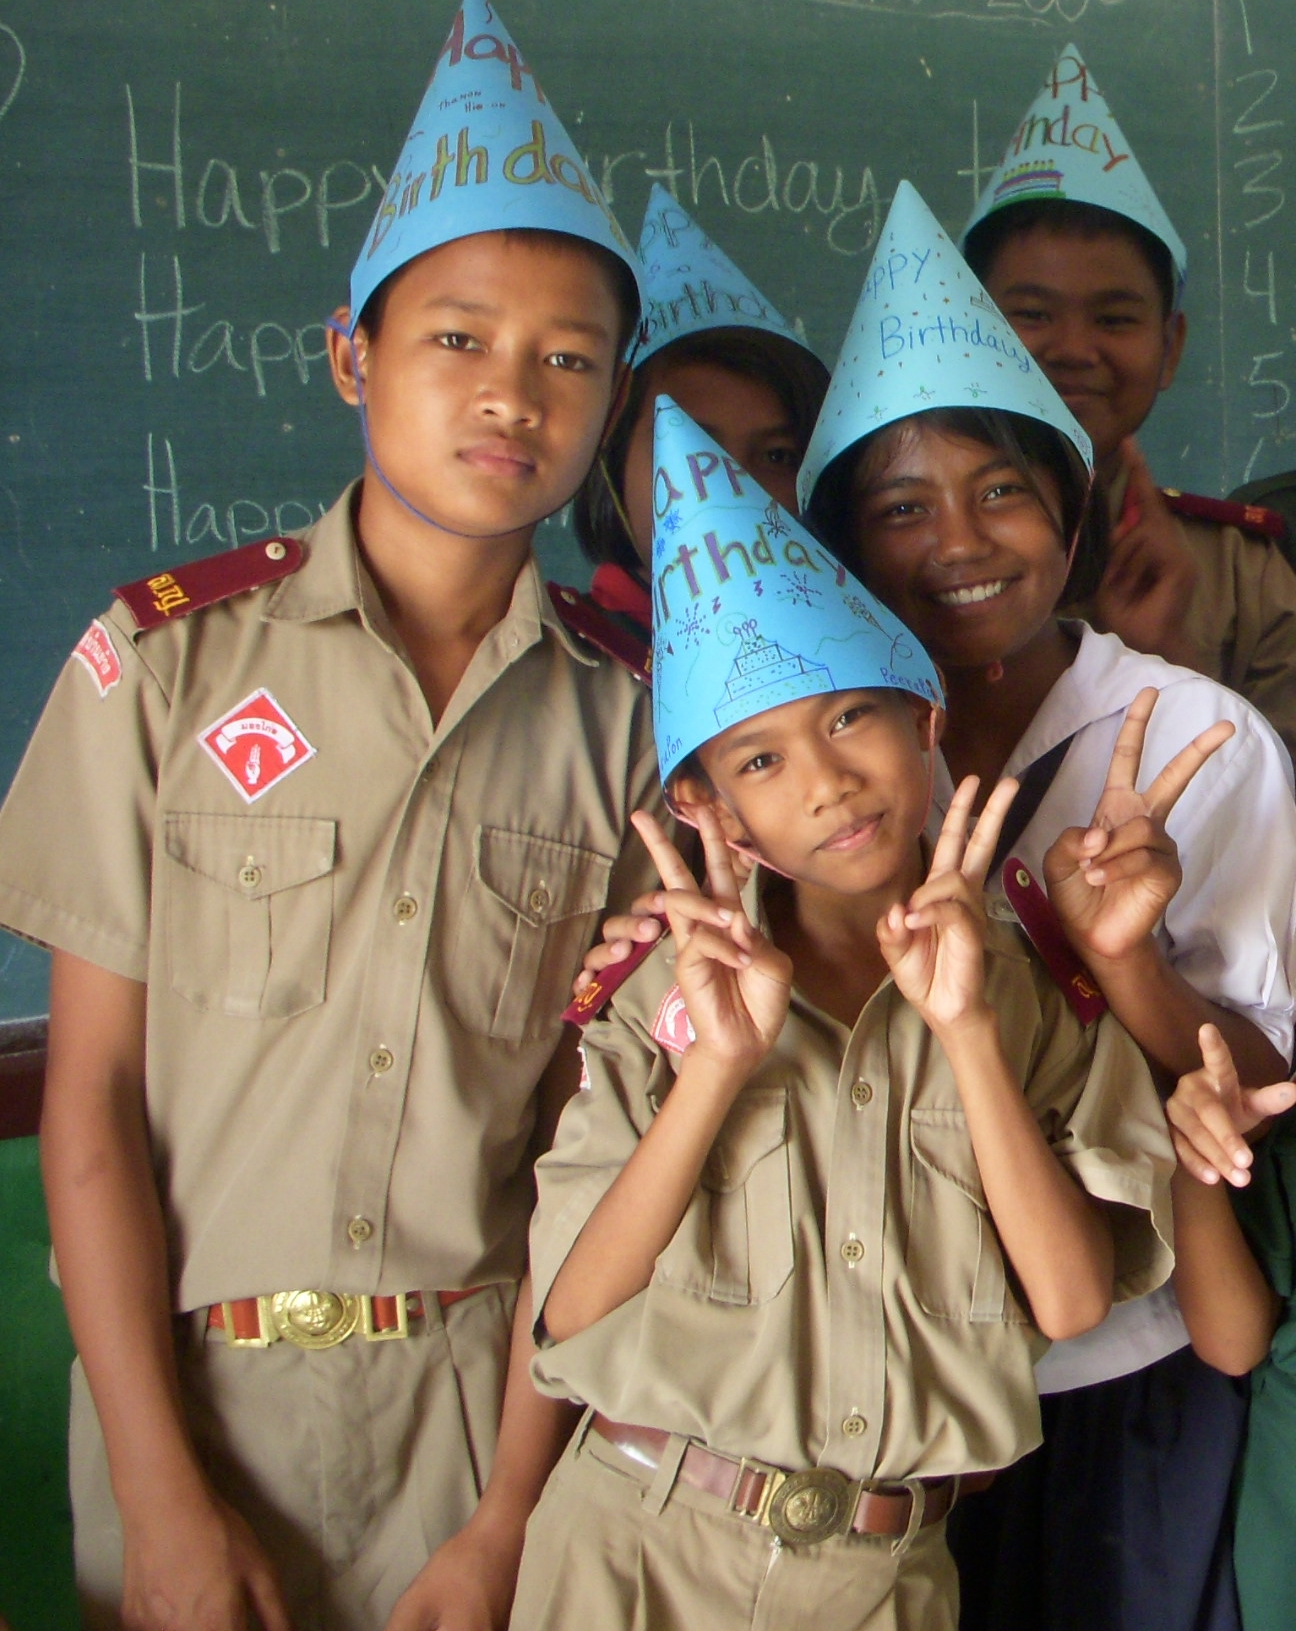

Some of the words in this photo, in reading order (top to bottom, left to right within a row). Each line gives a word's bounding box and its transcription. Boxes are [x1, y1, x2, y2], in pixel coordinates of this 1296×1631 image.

[1233, 69, 1284, 134] 2
[584, 120, 881, 255] rthday
[1234, 151, 1285, 227] 3
[1244, 250, 1276, 325] 4
[881, 316, 1032, 374] Birthday
[1248, 351, 1291, 418] 5
